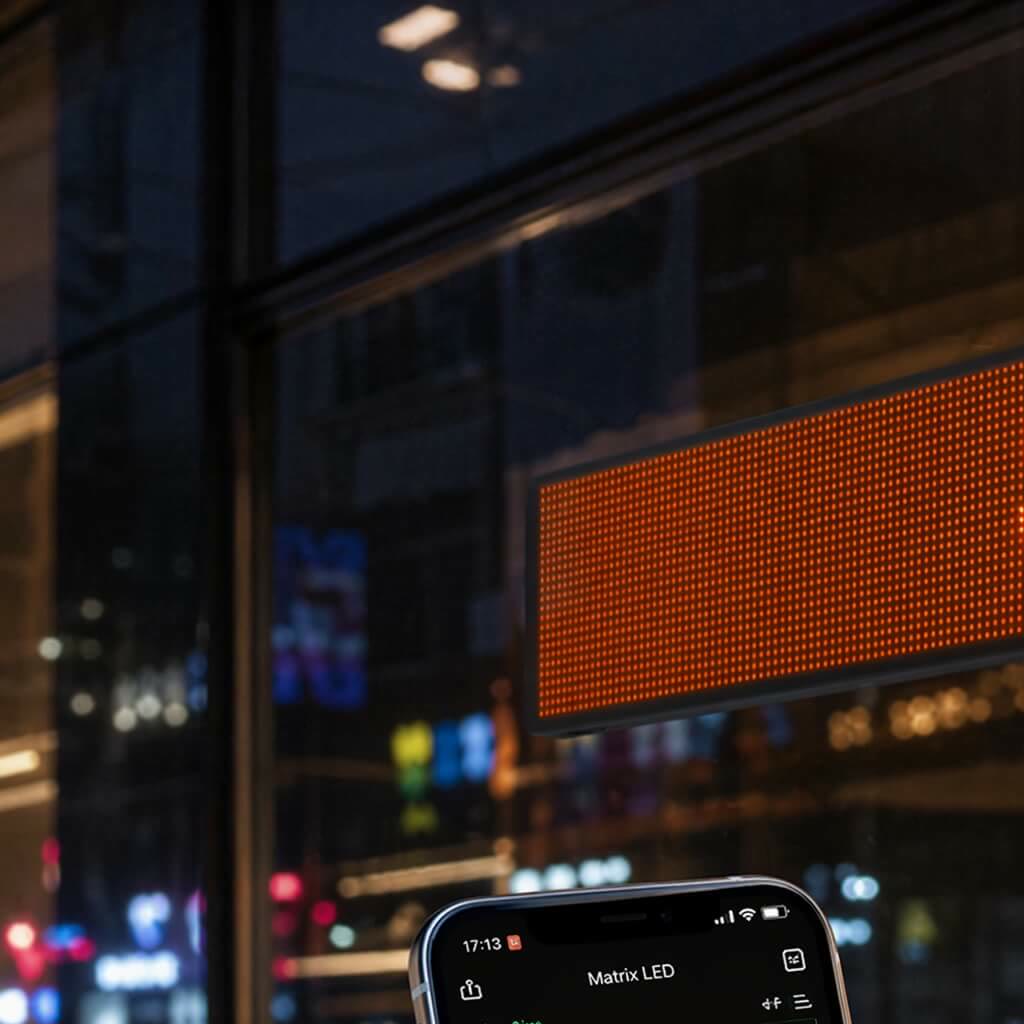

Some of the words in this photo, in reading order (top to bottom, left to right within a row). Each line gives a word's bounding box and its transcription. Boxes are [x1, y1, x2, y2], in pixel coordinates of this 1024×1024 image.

[463, 937, 502, 953] 17:13
[587, 967, 639, 986] Matrix
[642, 963, 676, 981] LED
